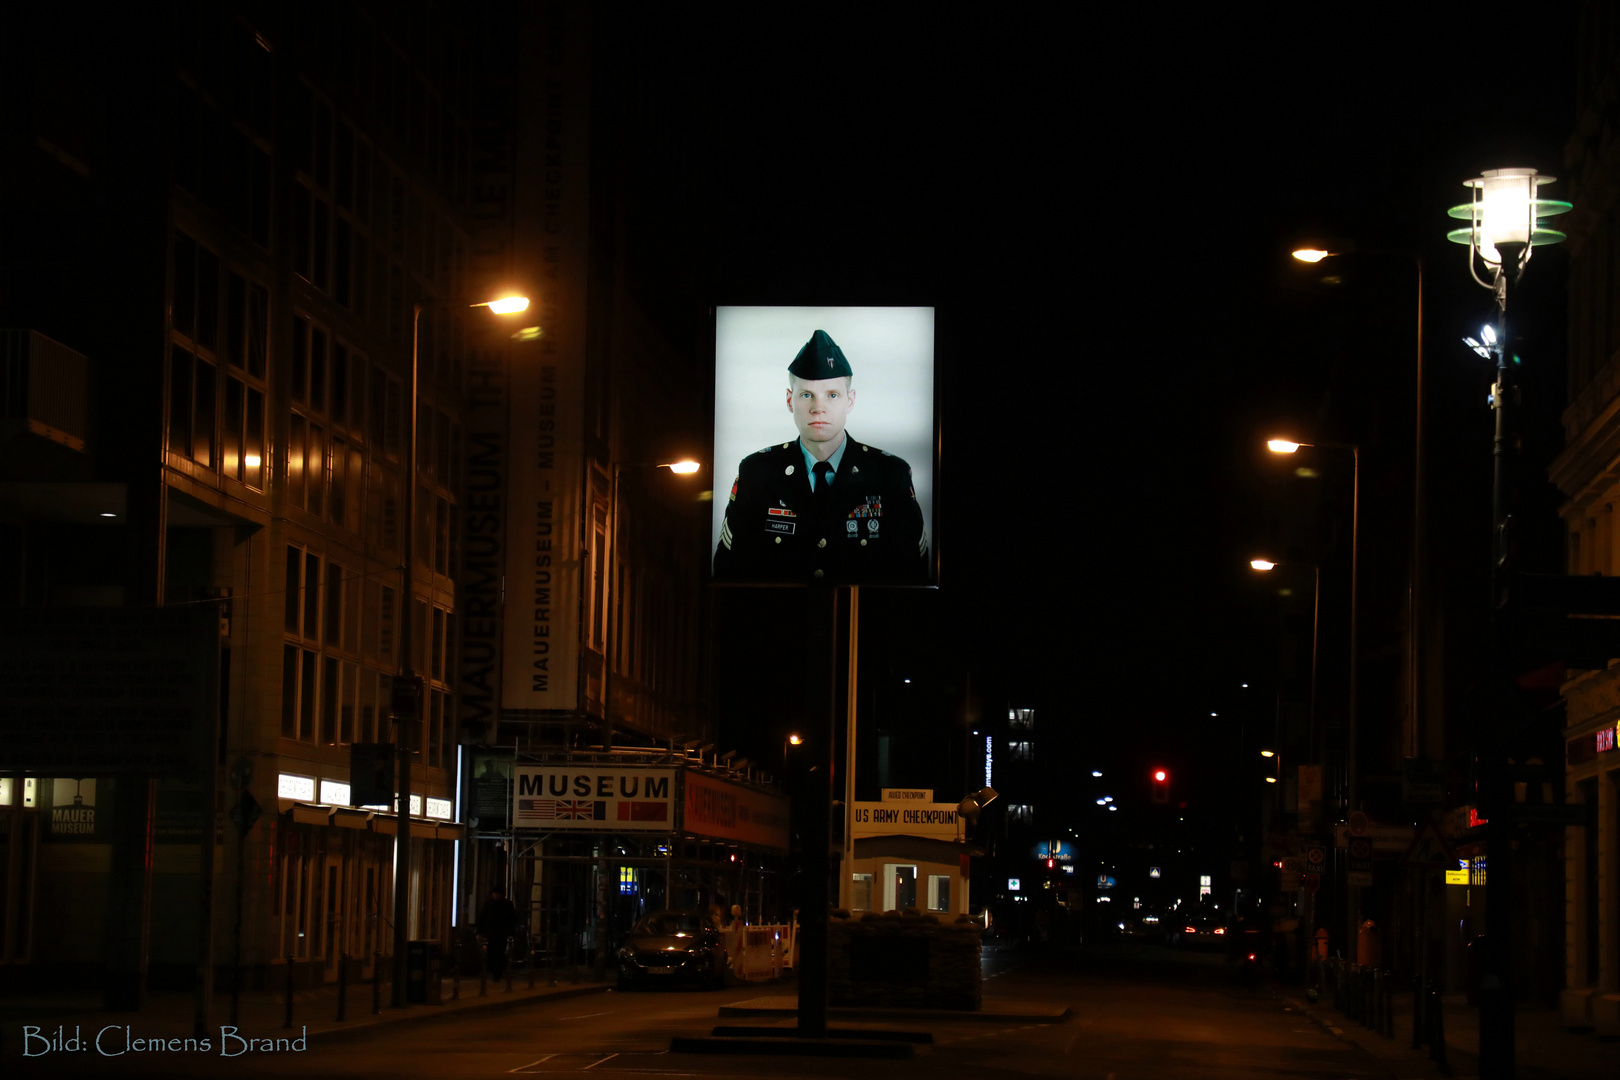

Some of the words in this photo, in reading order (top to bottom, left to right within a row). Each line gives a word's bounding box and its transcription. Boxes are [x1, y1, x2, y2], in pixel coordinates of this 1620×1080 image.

[537, 366, 556, 469] MUSEUM
[771, 523, 789, 531] HARPER
[533, 501, 553, 692] MAUERMUSEUM
[519, 775, 669, 798] MUSEUM
[888, 791, 902, 800] ALLIED
[902, 791, 926, 800] CHECKPOINT
[52, 809, 96, 822] MAUER
[873, 810, 899, 824] ARMY
[903, 810, 958, 825] CHECKPOINT
[51, 823, 96, 835] MUSEUM
